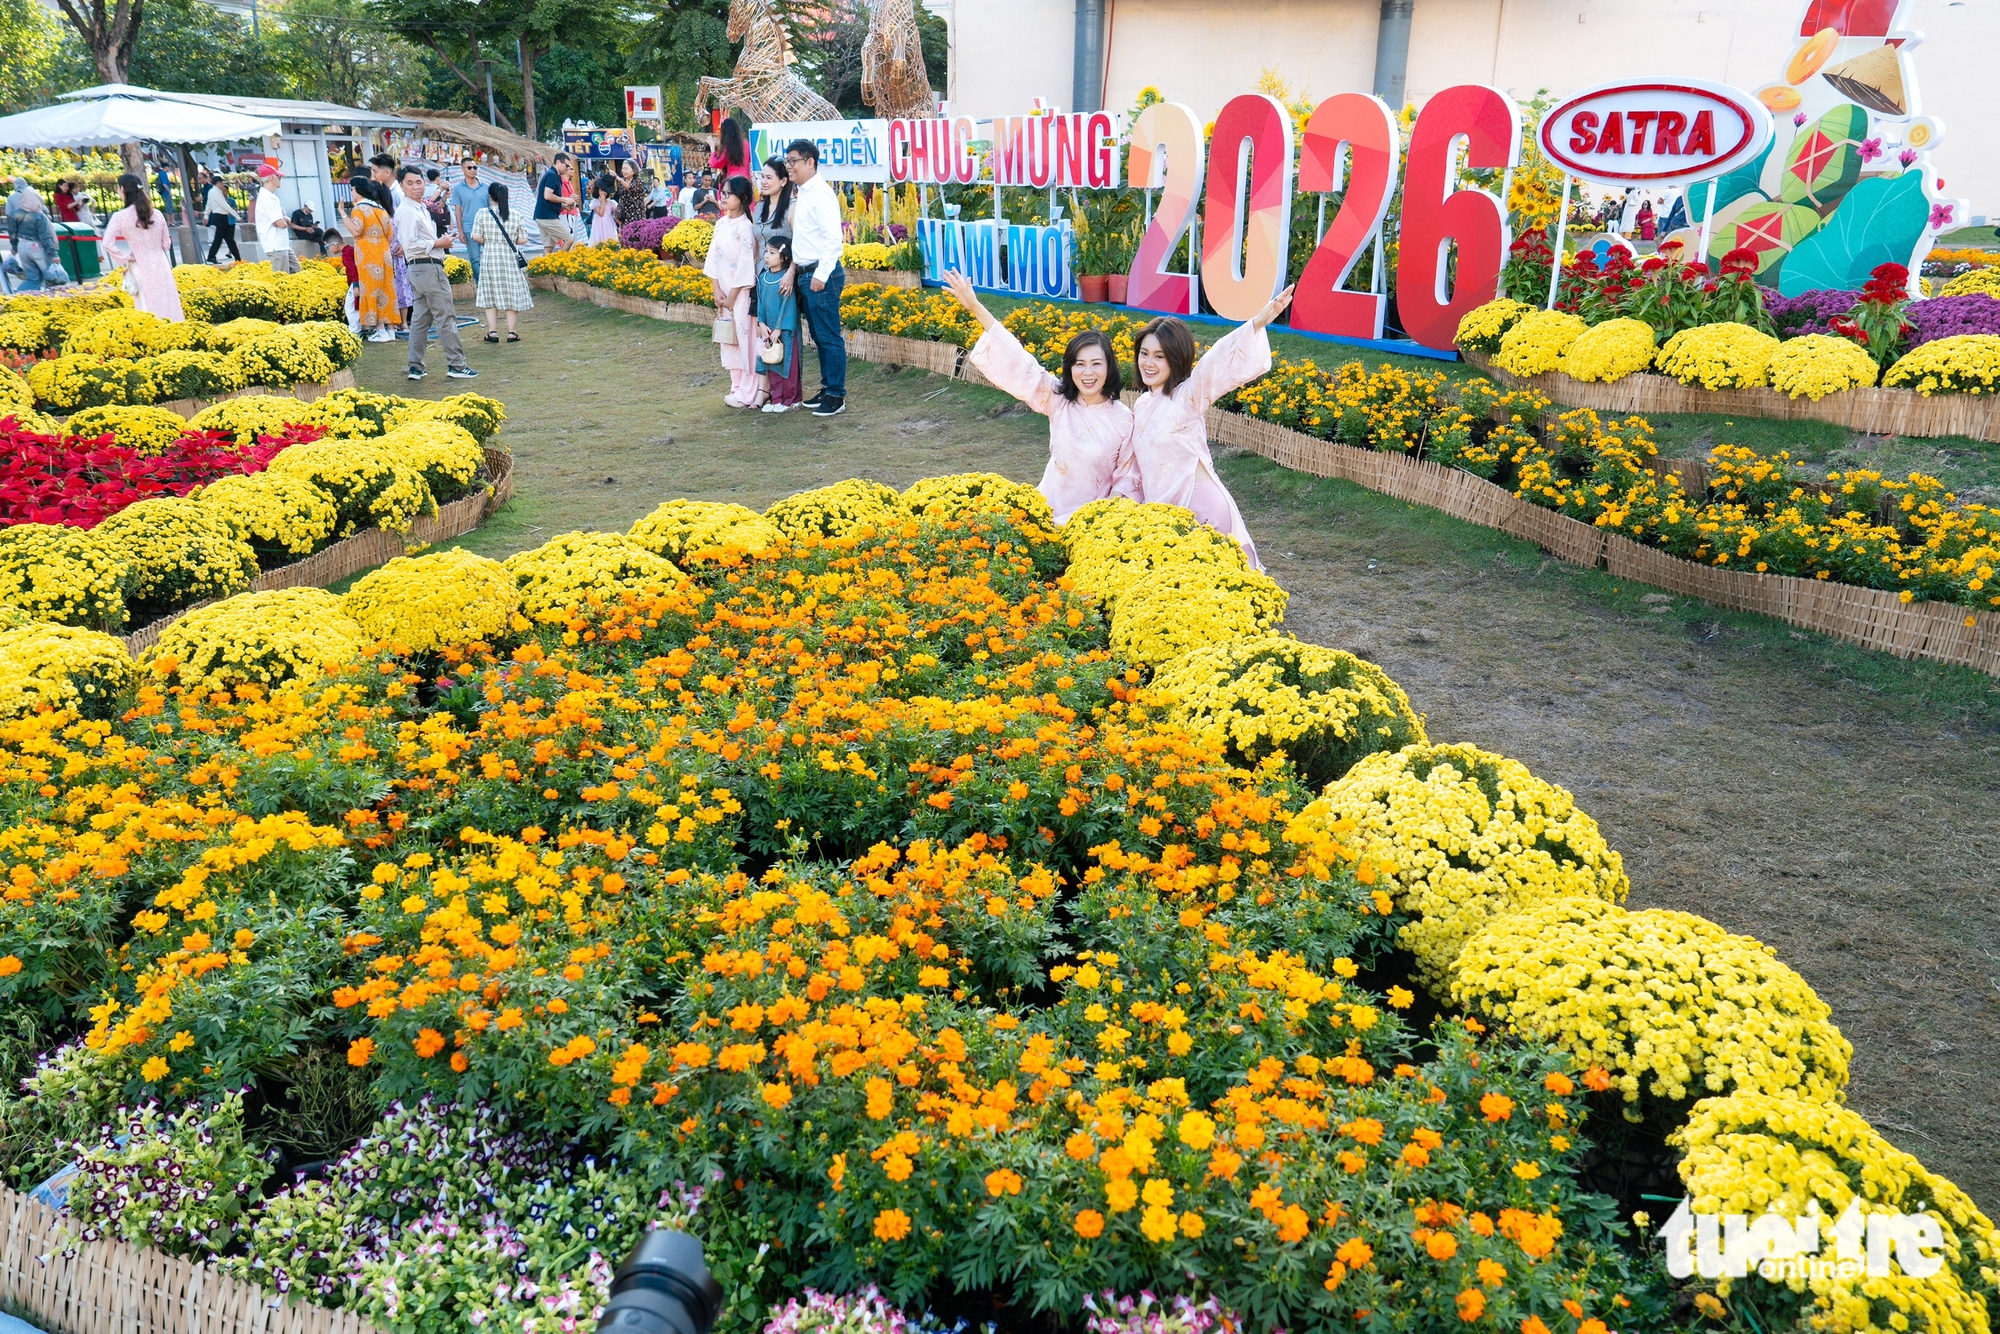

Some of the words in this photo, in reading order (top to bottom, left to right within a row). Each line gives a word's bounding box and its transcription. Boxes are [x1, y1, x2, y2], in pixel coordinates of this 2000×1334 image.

[831, 121, 878, 165] ĐIỀN
[889, 101, 977, 184] CHÚC
[1569, 110, 1716, 155] SATRA
[917, 203, 997, 289] NĂM
[1127, 84, 1517, 352] 2026
